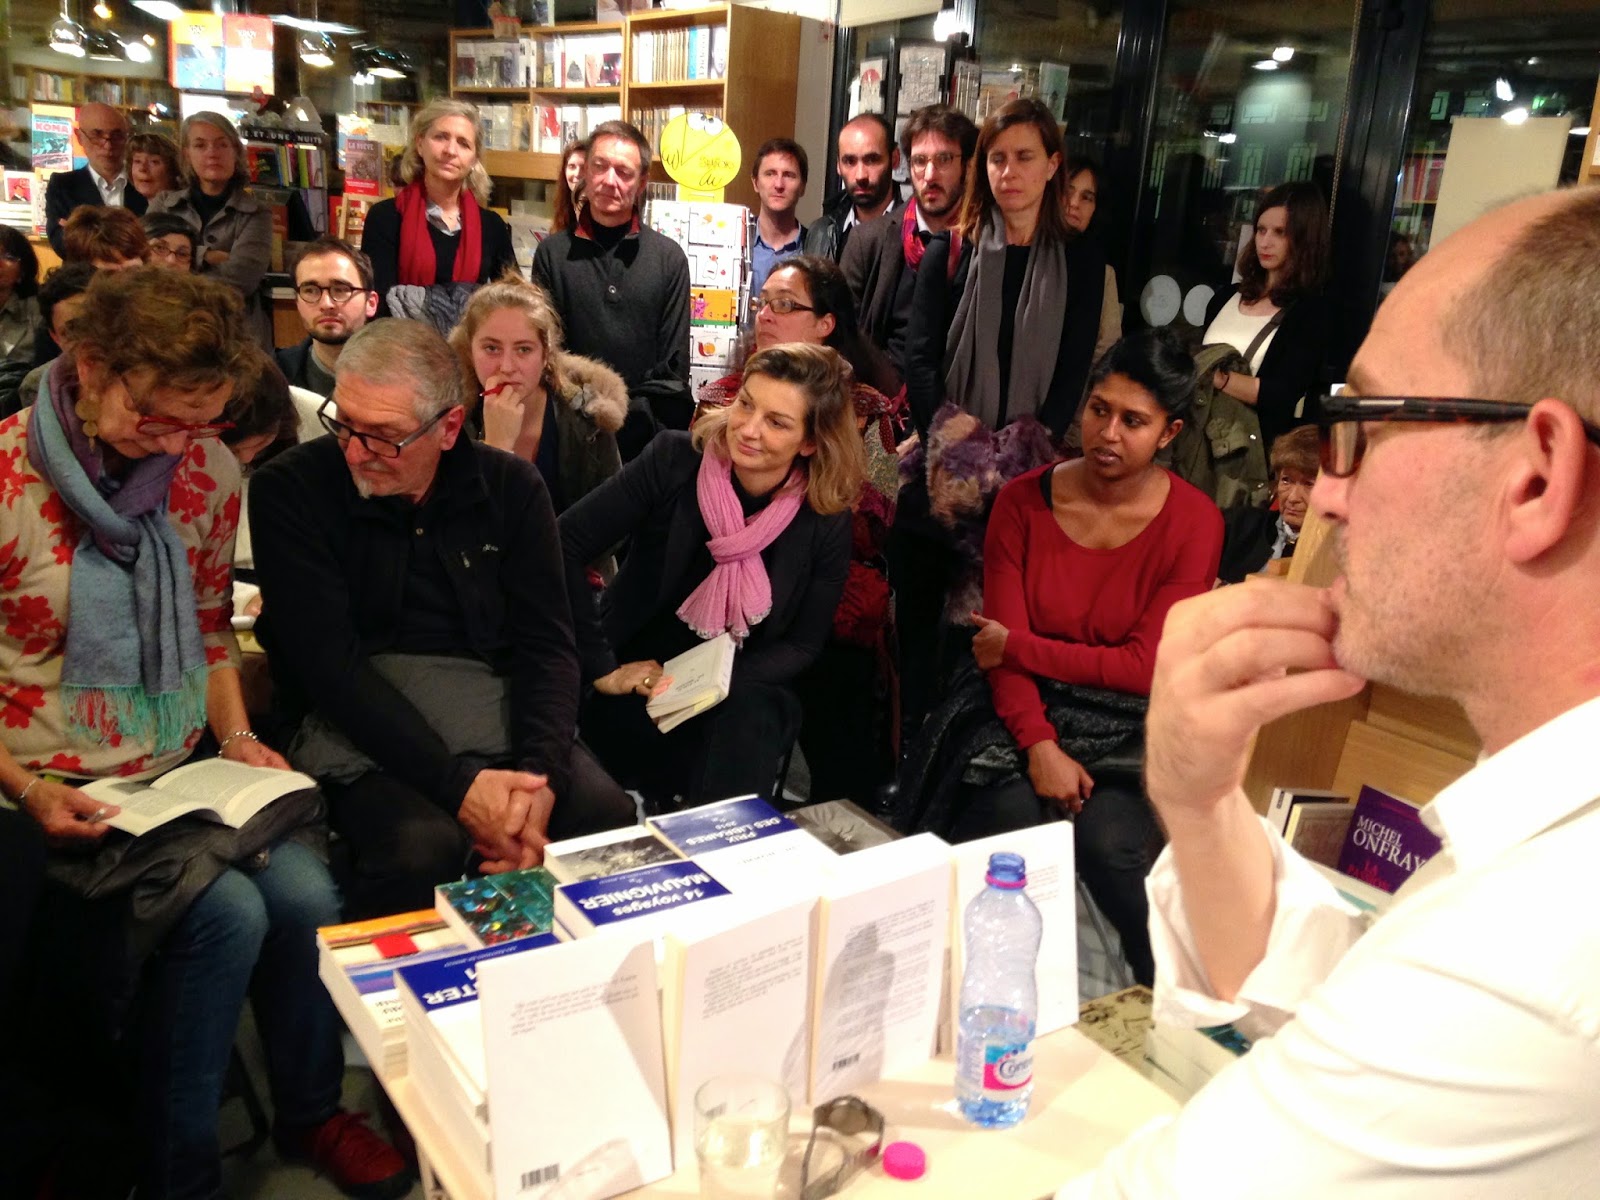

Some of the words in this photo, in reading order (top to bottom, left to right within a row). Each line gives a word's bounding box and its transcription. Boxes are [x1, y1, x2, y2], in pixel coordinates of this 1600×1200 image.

[35, 122, 69, 133] KOMA
[270, 133, 290, 141] UNE
[297, 135, 322, 144] NUITS
[753, 816, 781, 829] DES
[1356, 815, 1403, 848] MICHEL
[685, 824, 754, 846] LIBRAIRES
[725, 832, 757, 843] PRIX
[1352, 828, 1426, 872] ONFRAY
[578, 873, 711, 910] MAUVIGNIER
[683, 888, 704, 901] 14
[612, 892, 683, 916] voyages
[422, 984, 480, 1005] TER
